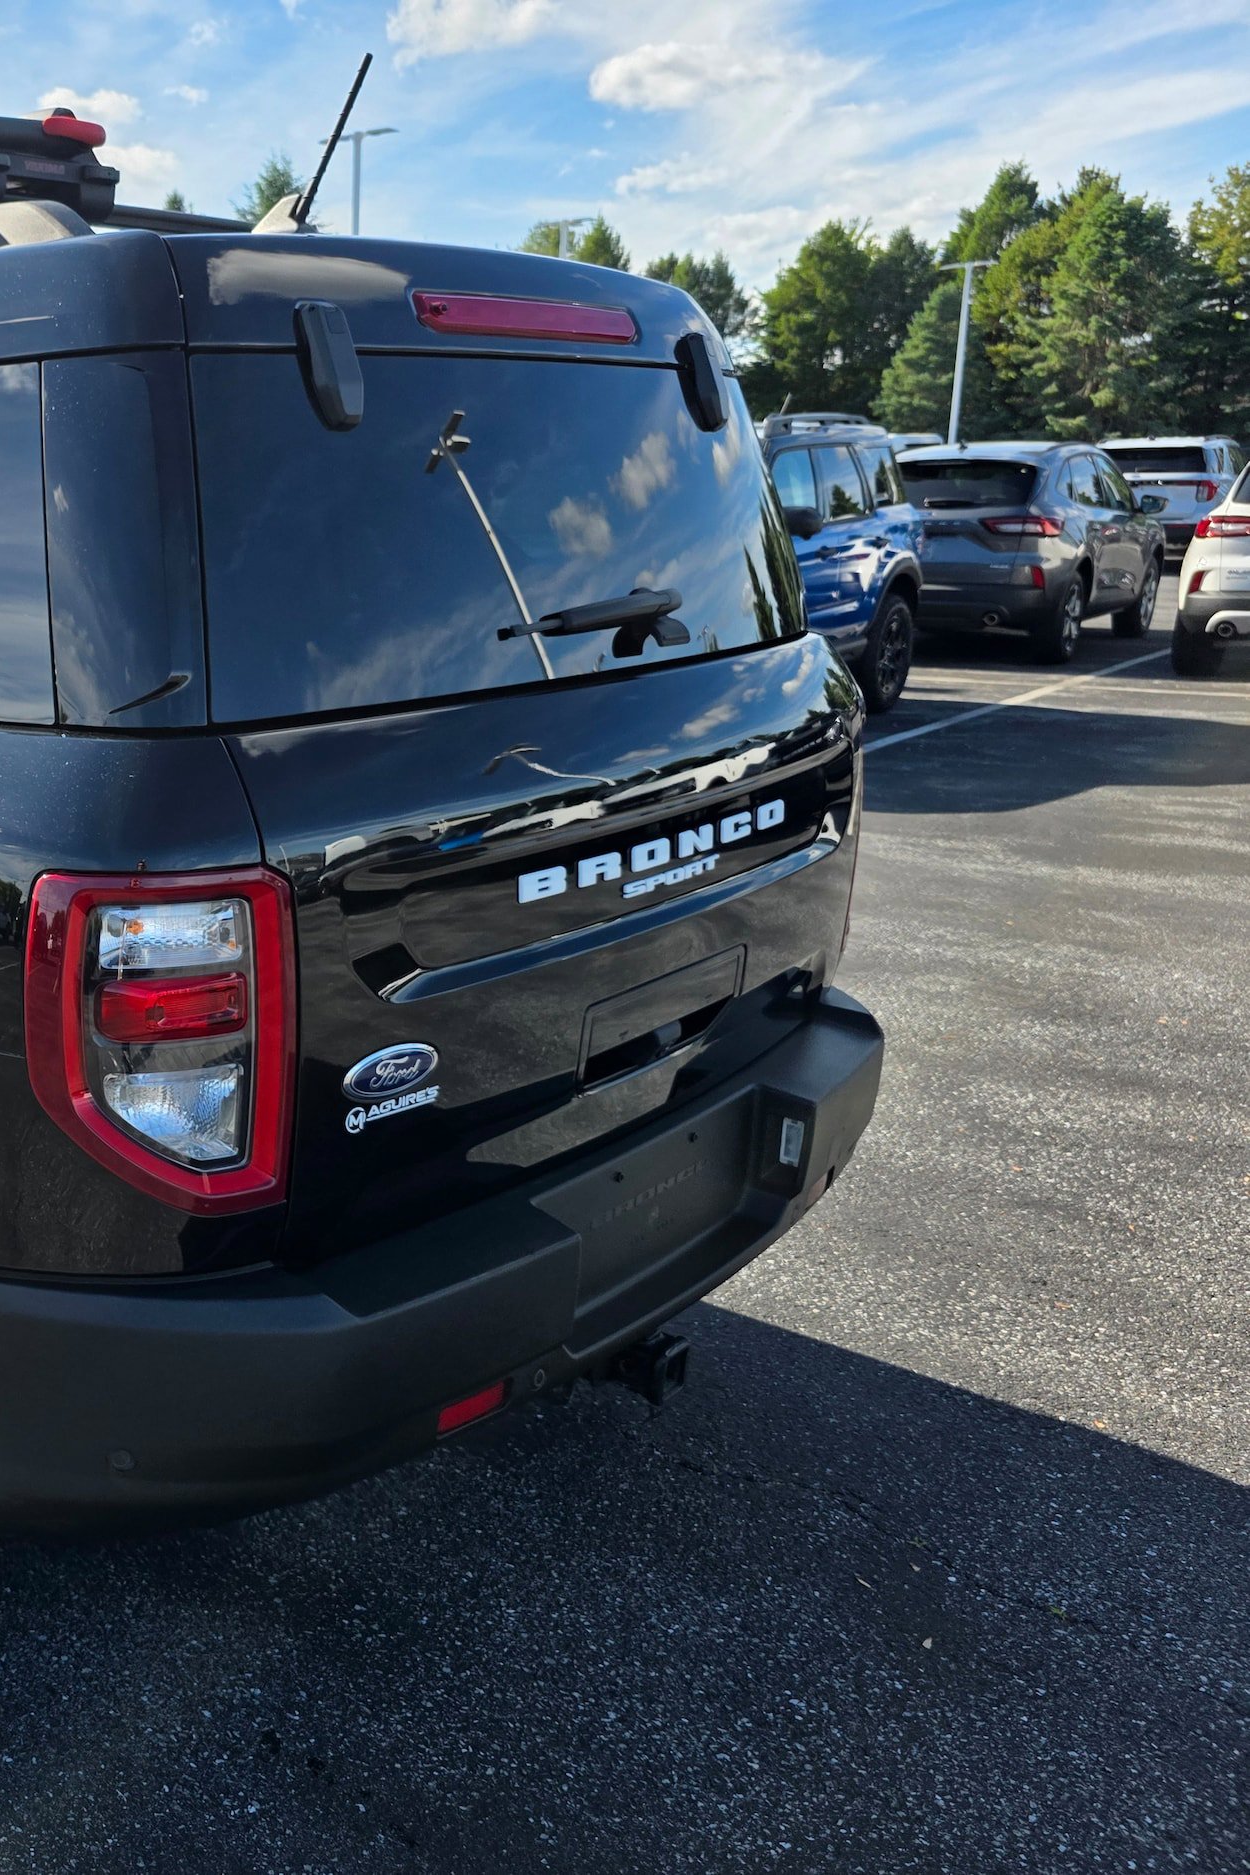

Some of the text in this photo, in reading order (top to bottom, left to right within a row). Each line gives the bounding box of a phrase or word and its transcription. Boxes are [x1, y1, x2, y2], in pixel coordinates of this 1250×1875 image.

[518, 799, 785, 904] BRONCO
[622, 853, 720, 899] SPORT
[370, 1055, 421, 1089] Ford
